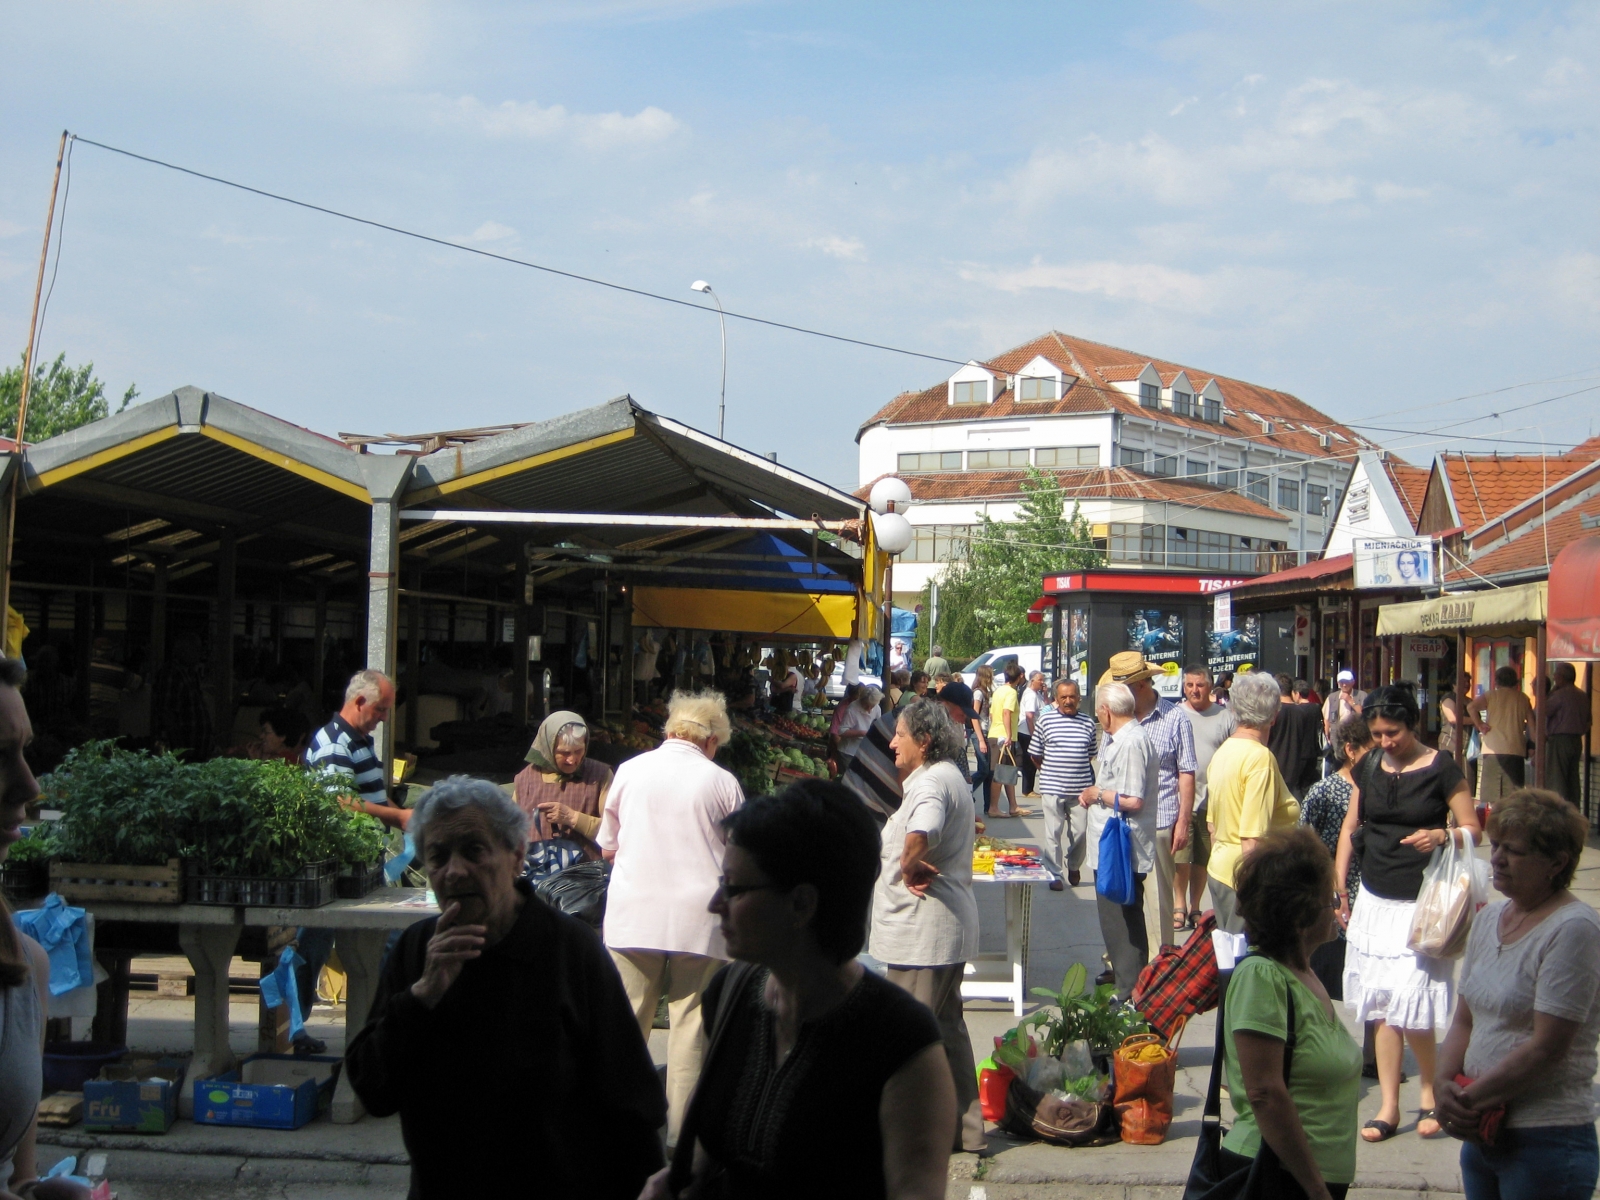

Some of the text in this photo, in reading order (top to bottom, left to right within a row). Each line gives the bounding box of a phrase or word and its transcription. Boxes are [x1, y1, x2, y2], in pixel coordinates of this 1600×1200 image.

[1364, 541, 1422, 549] MJENJAČNICA
[1056, 577, 1071, 589] TISAK
[1409, 644, 1441, 653] KEBAP
[1148, 650, 1180, 661] INTERNET
[1208, 652, 1257, 665] UZMI INTERNET
